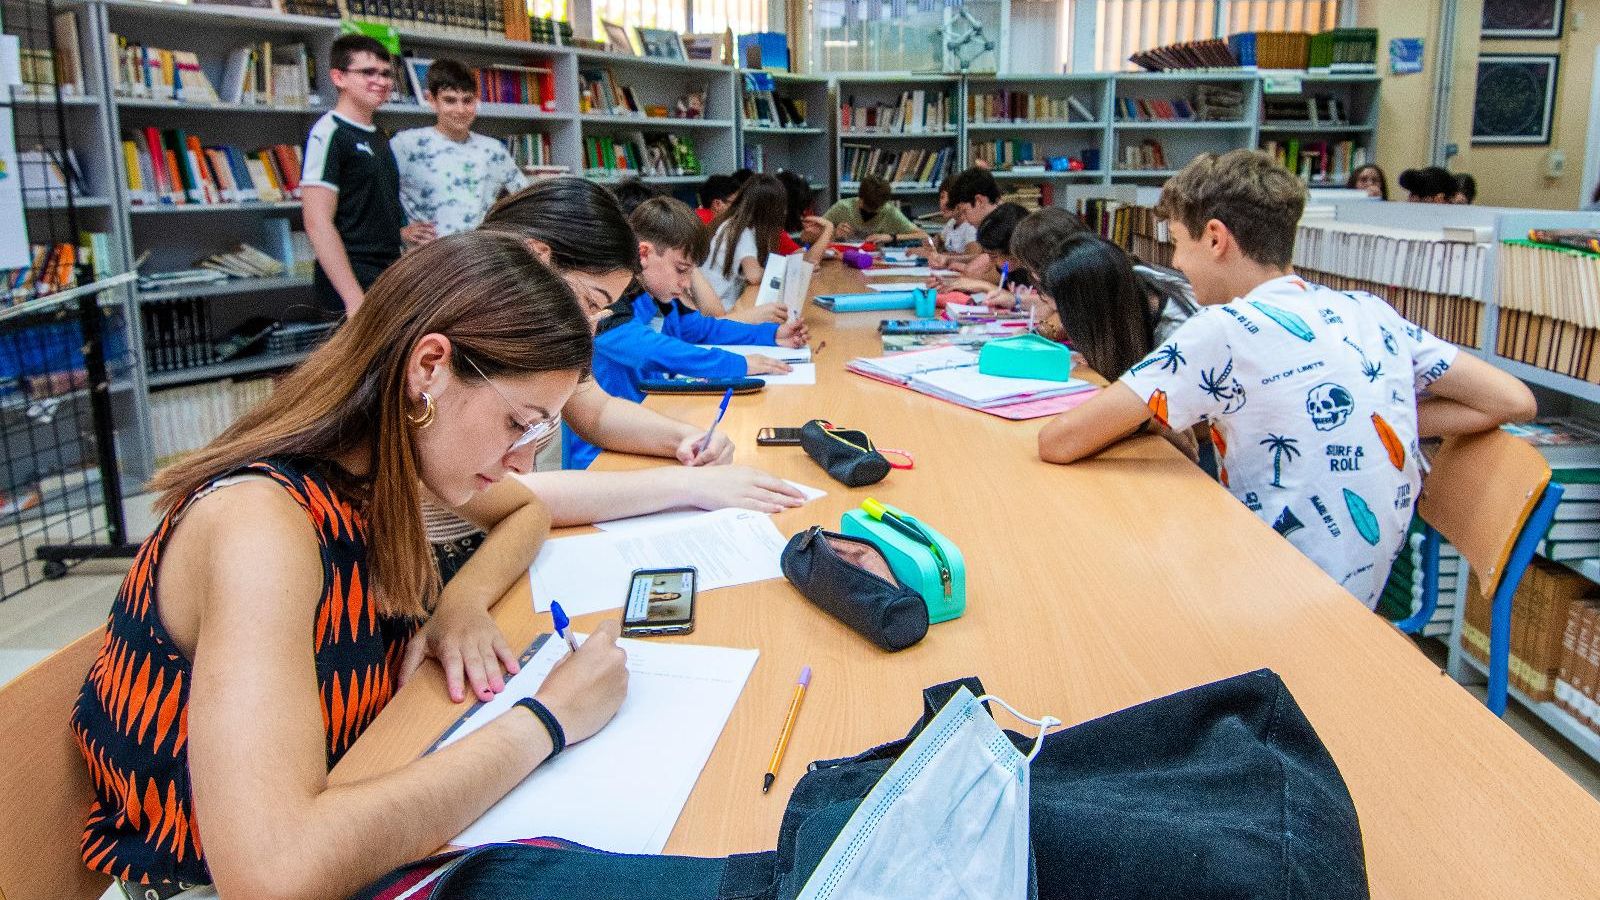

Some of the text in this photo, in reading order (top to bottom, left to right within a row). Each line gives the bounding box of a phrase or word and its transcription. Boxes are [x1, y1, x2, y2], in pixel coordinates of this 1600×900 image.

[1261, 361, 1325, 385] OUT OF LIMITS
[1326, 444, 1364, 457] SURF &
[1330, 458, 1360, 472] ROLL
